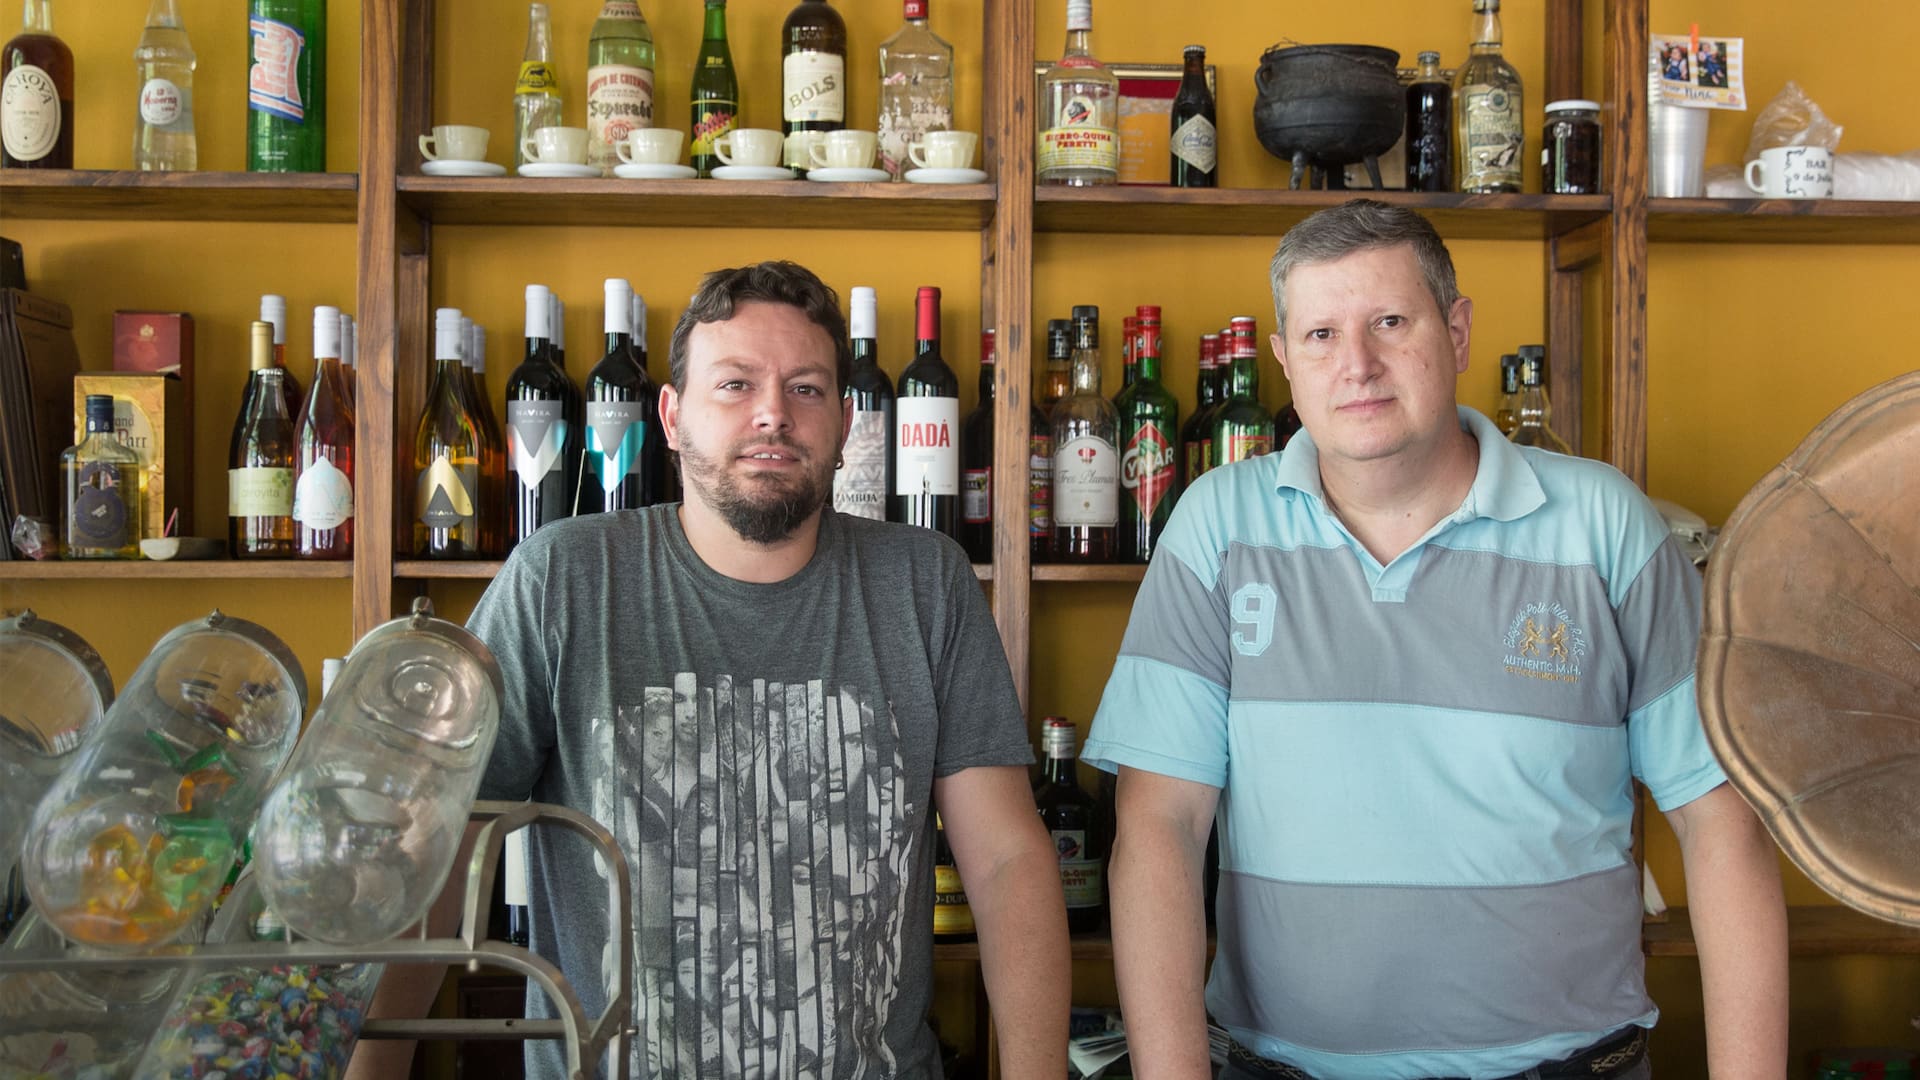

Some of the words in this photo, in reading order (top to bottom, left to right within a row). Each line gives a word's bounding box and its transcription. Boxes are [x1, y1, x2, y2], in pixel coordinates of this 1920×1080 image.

[789, 75, 836, 109] BOLS
[115, 416, 134, 427] and
[902, 418, 951, 448] DADÁ
[1231, 582, 1277, 656] 9
[1503, 655, 1554, 673] AUTHENTIC
